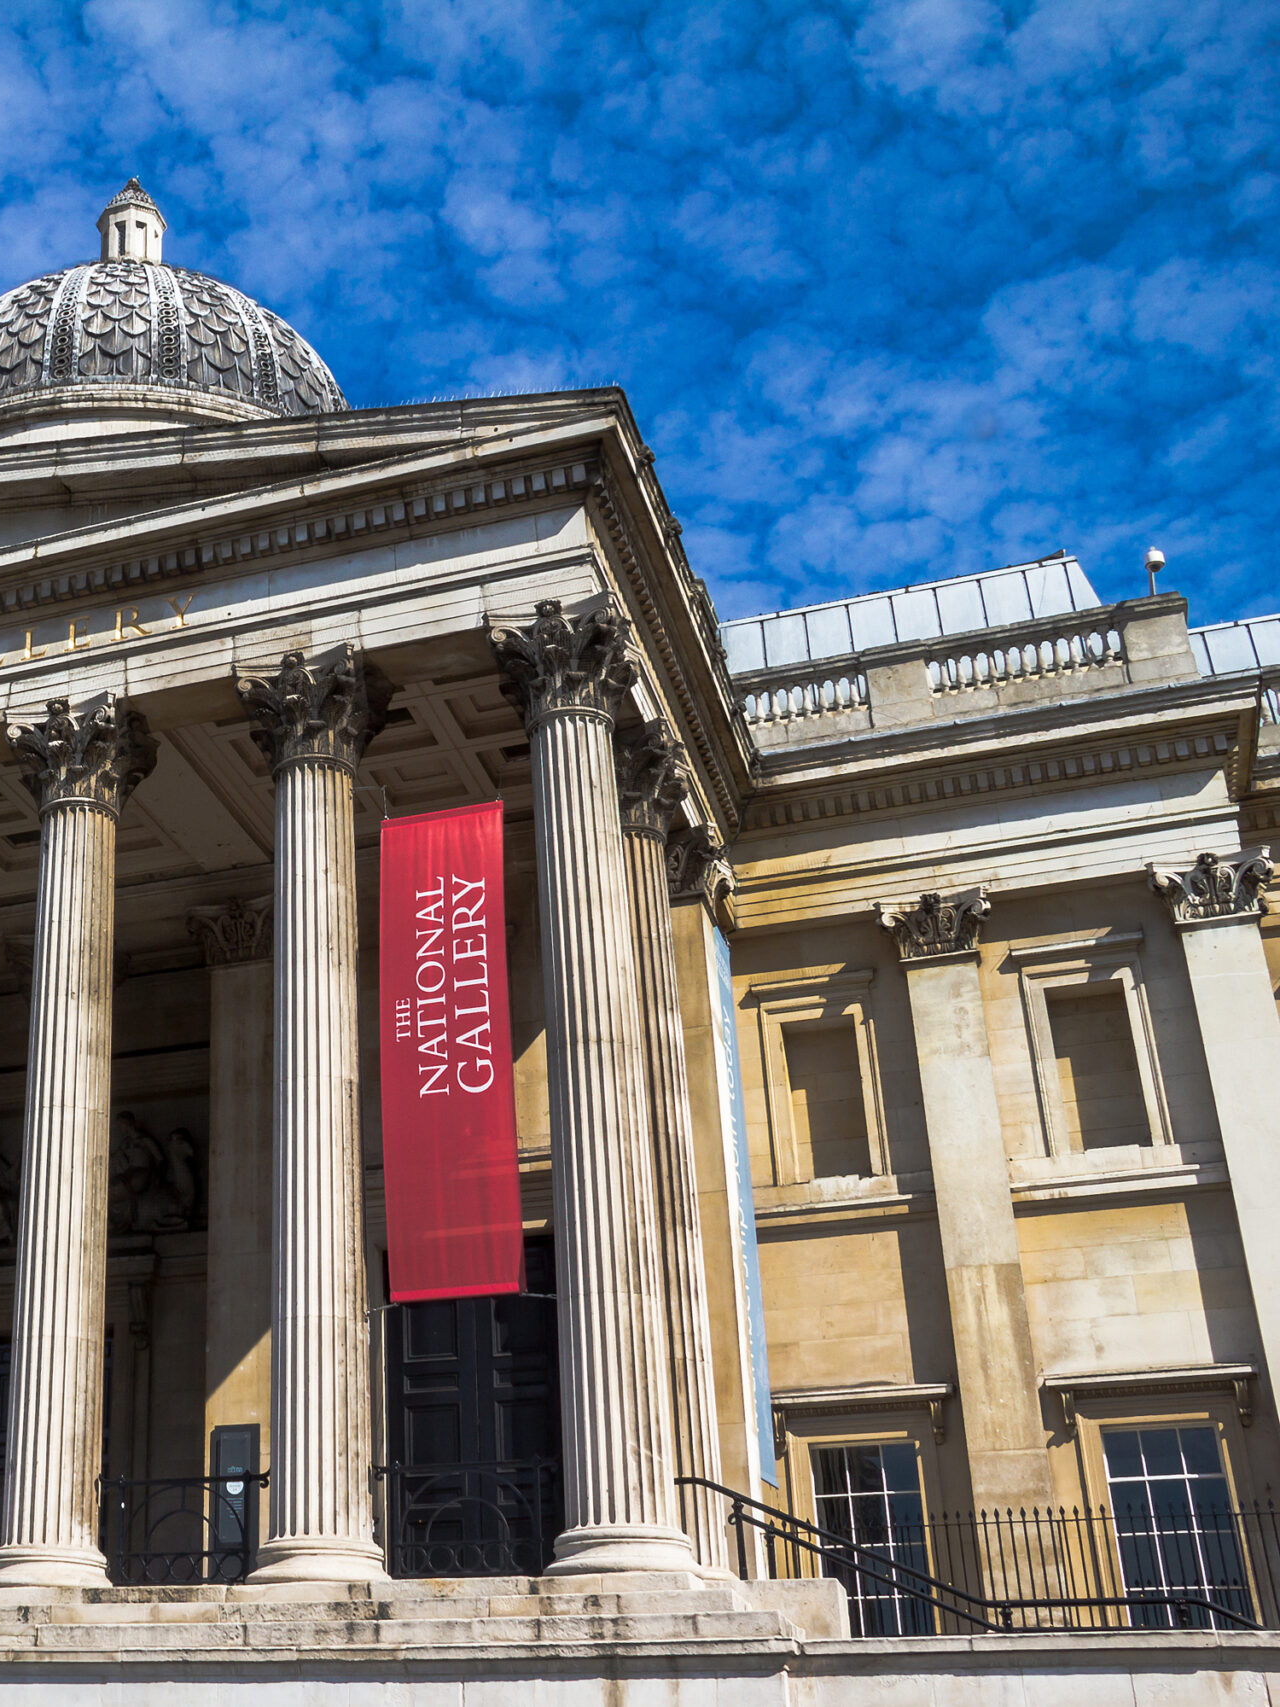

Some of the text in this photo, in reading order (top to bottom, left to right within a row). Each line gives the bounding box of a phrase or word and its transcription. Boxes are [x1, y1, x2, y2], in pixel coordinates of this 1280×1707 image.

[396, 997, 411, 1042] THE
[415, 876, 450, 1098] NATIONAL
[451, 873, 494, 1094] GALLERY
